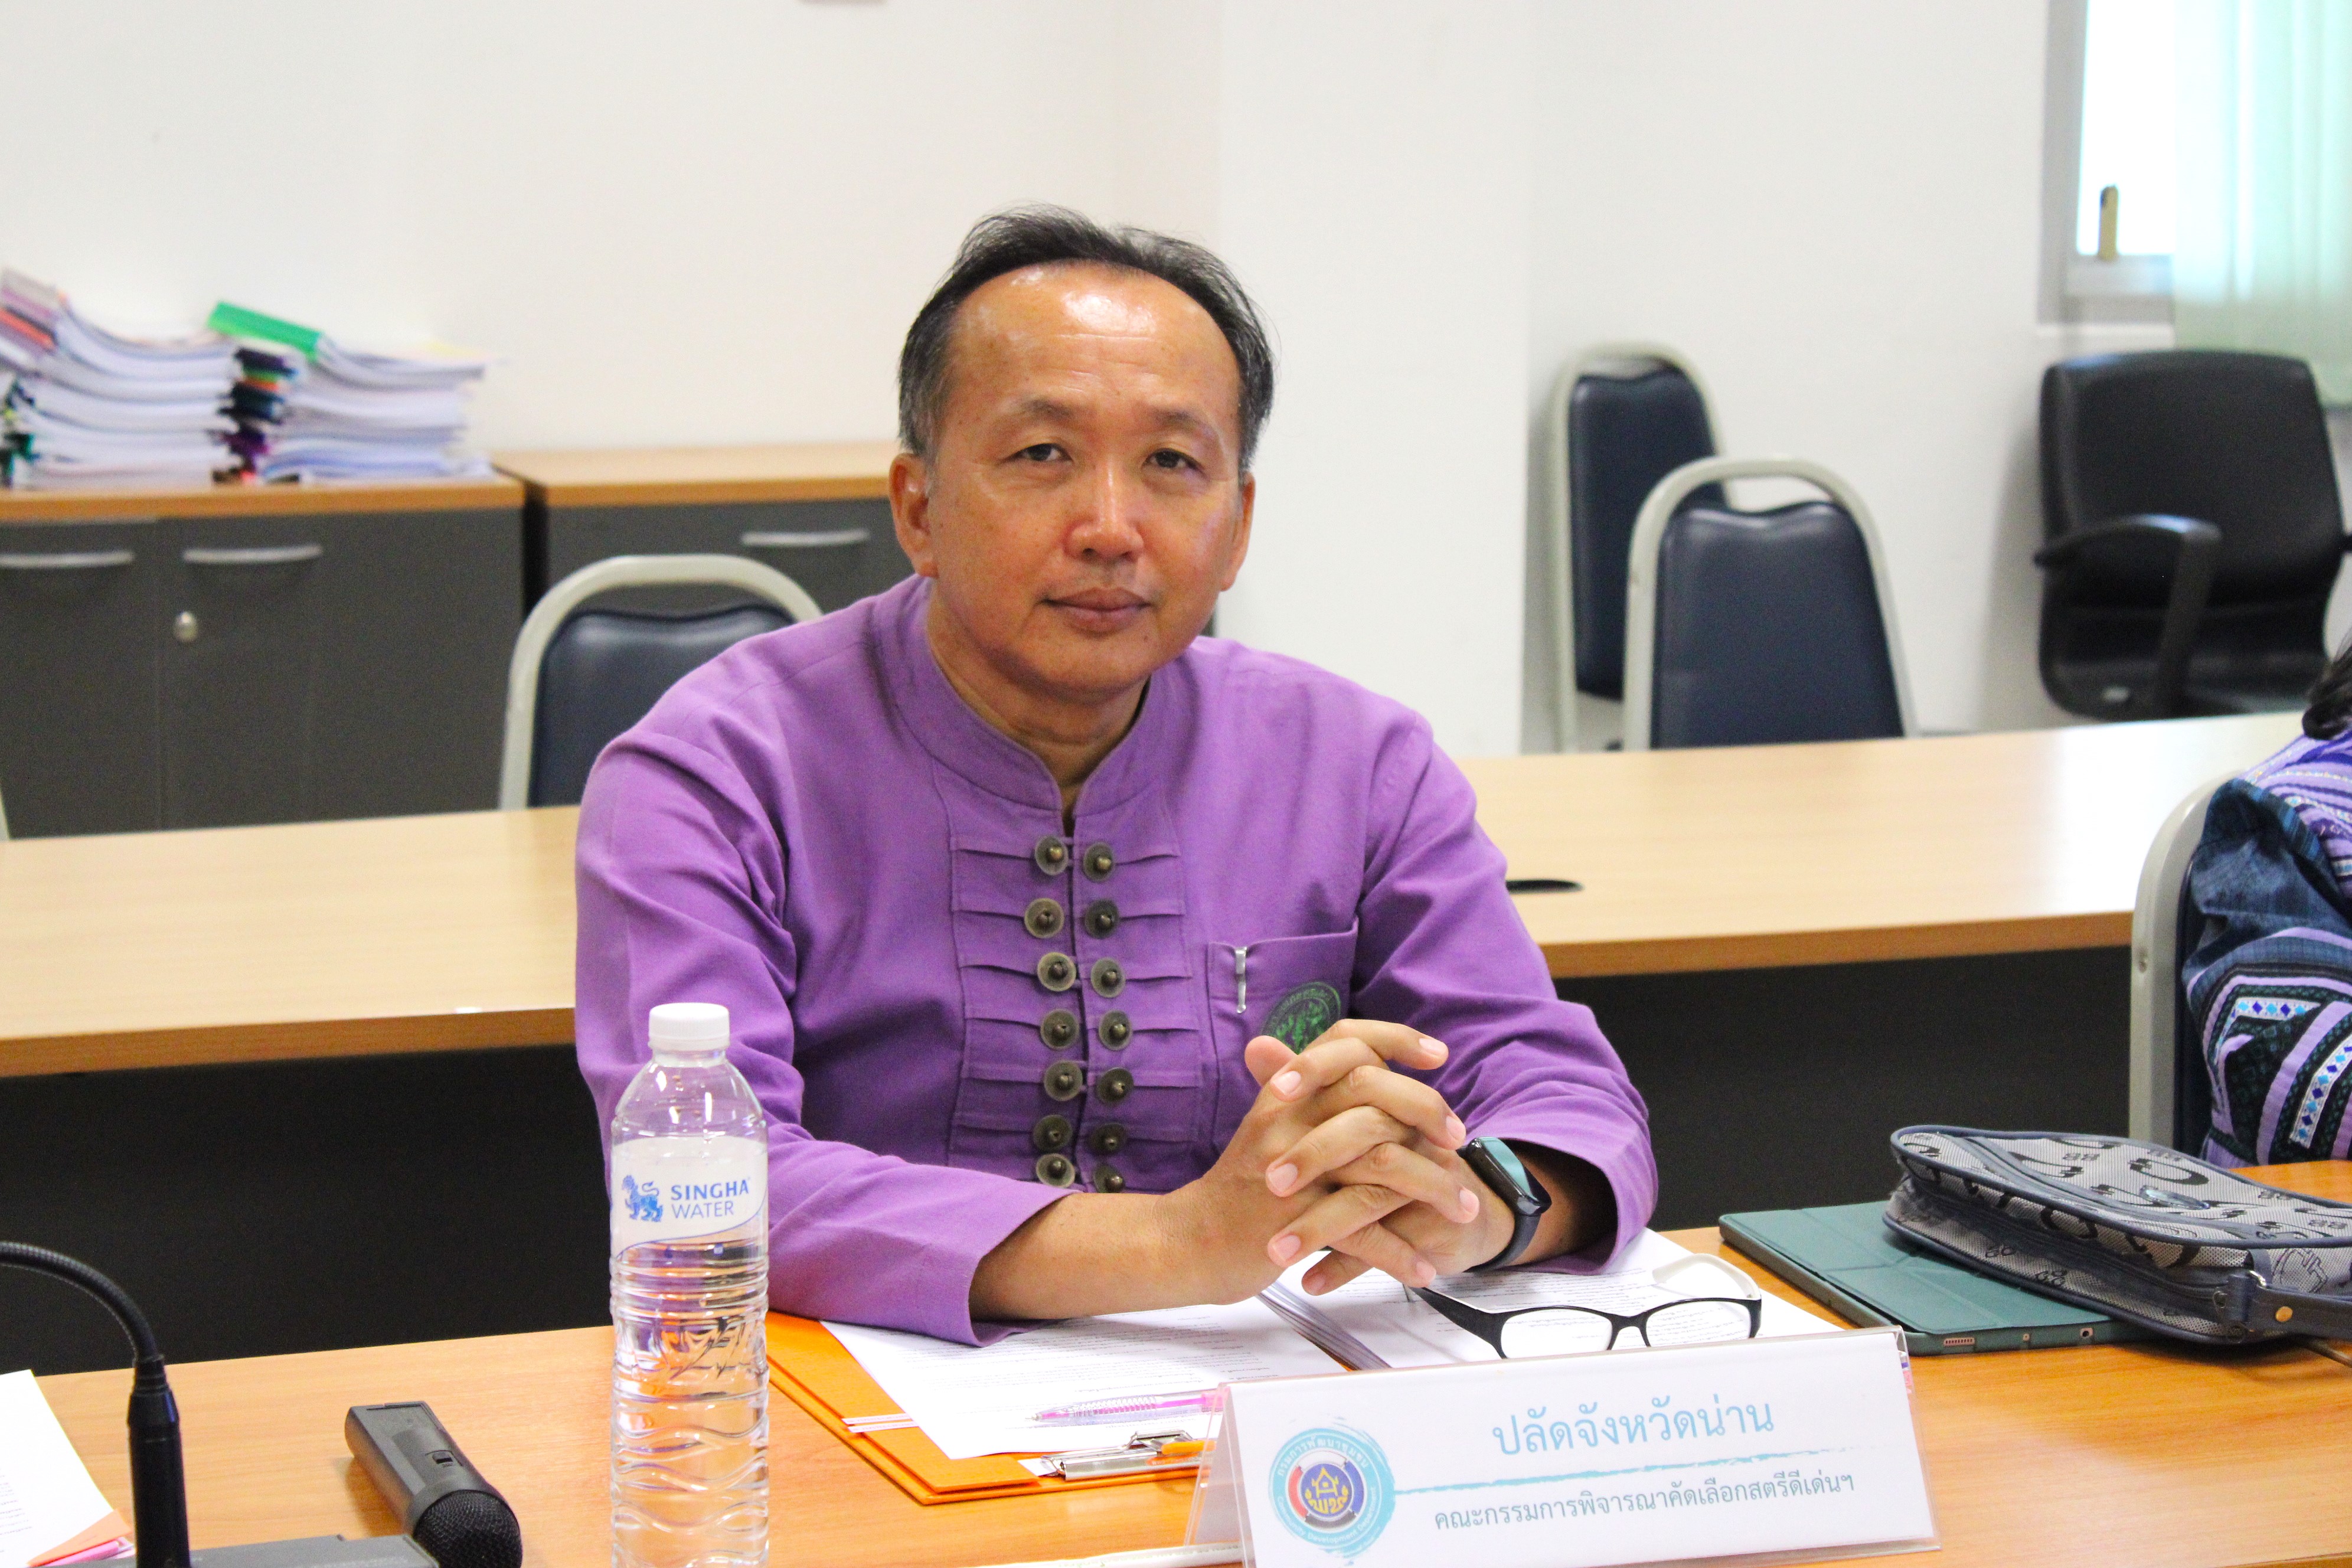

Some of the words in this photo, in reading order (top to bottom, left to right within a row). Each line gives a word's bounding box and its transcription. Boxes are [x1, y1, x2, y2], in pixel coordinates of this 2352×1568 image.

[671, 1179, 749, 1200] SINGHA
[671, 1201, 734, 1219] WATER
[1492, 1393, 1775, 1455] ปลัดจังหวัดน่าน
[1278, 1436, 1368, 1476] กรมการพัฒนาชุมชน
[1435, 1469, 1855, 1530] คณะกรรมการพิจารณาคัดเลือกสตรีดีเด่นฯ
